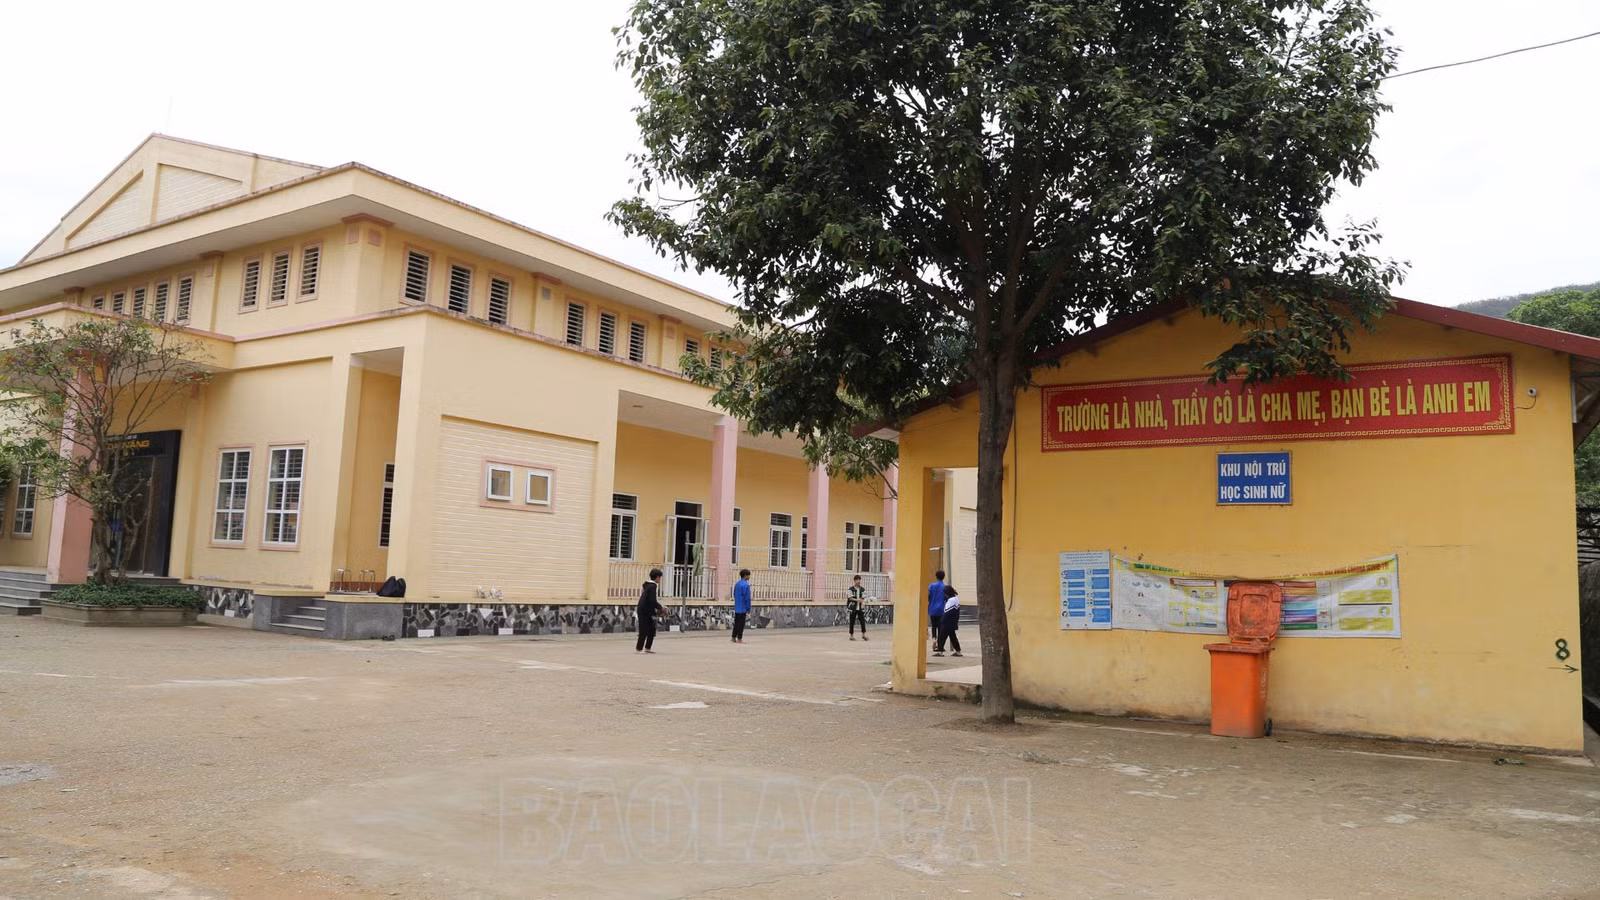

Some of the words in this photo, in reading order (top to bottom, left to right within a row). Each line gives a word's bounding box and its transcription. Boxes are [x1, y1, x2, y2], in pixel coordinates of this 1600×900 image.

[1057, 398, 1109, 432] TRƯỜNG
[1113, 396, 1130, 430] LÀ
[1135, 394, 1168, 430] NHÀ,
[1172, 388, 1208, 426] THẦY
[1213, 390, 1233, 425] CÔ
[1238, 388, 1256, 423] LÀ
[1261, 392, 1292, 422] CHA
[1297, 391, 1326, 426] MẸ,
[1331, 388, 1365, 425] BẠN
[1369, 380, 1391, 417] BÈ
[1396, 379, 1418, 416] LÀ
[1422, 383, 1458, 415] ANH
[1463, 381, 1491, 413] EM
[1221, 463, 1240, 477] KHU
[1244, 460, 1262, 478] NỘI
[1266, 459, 1286, 476] TRÚ
[1221, 485, 1240, 502] HỌC
[1243, 485, 1267, 499] SINH
[1270, 482, 1286, 499] NỮ
[1555, 638, 1570, 661] 8
